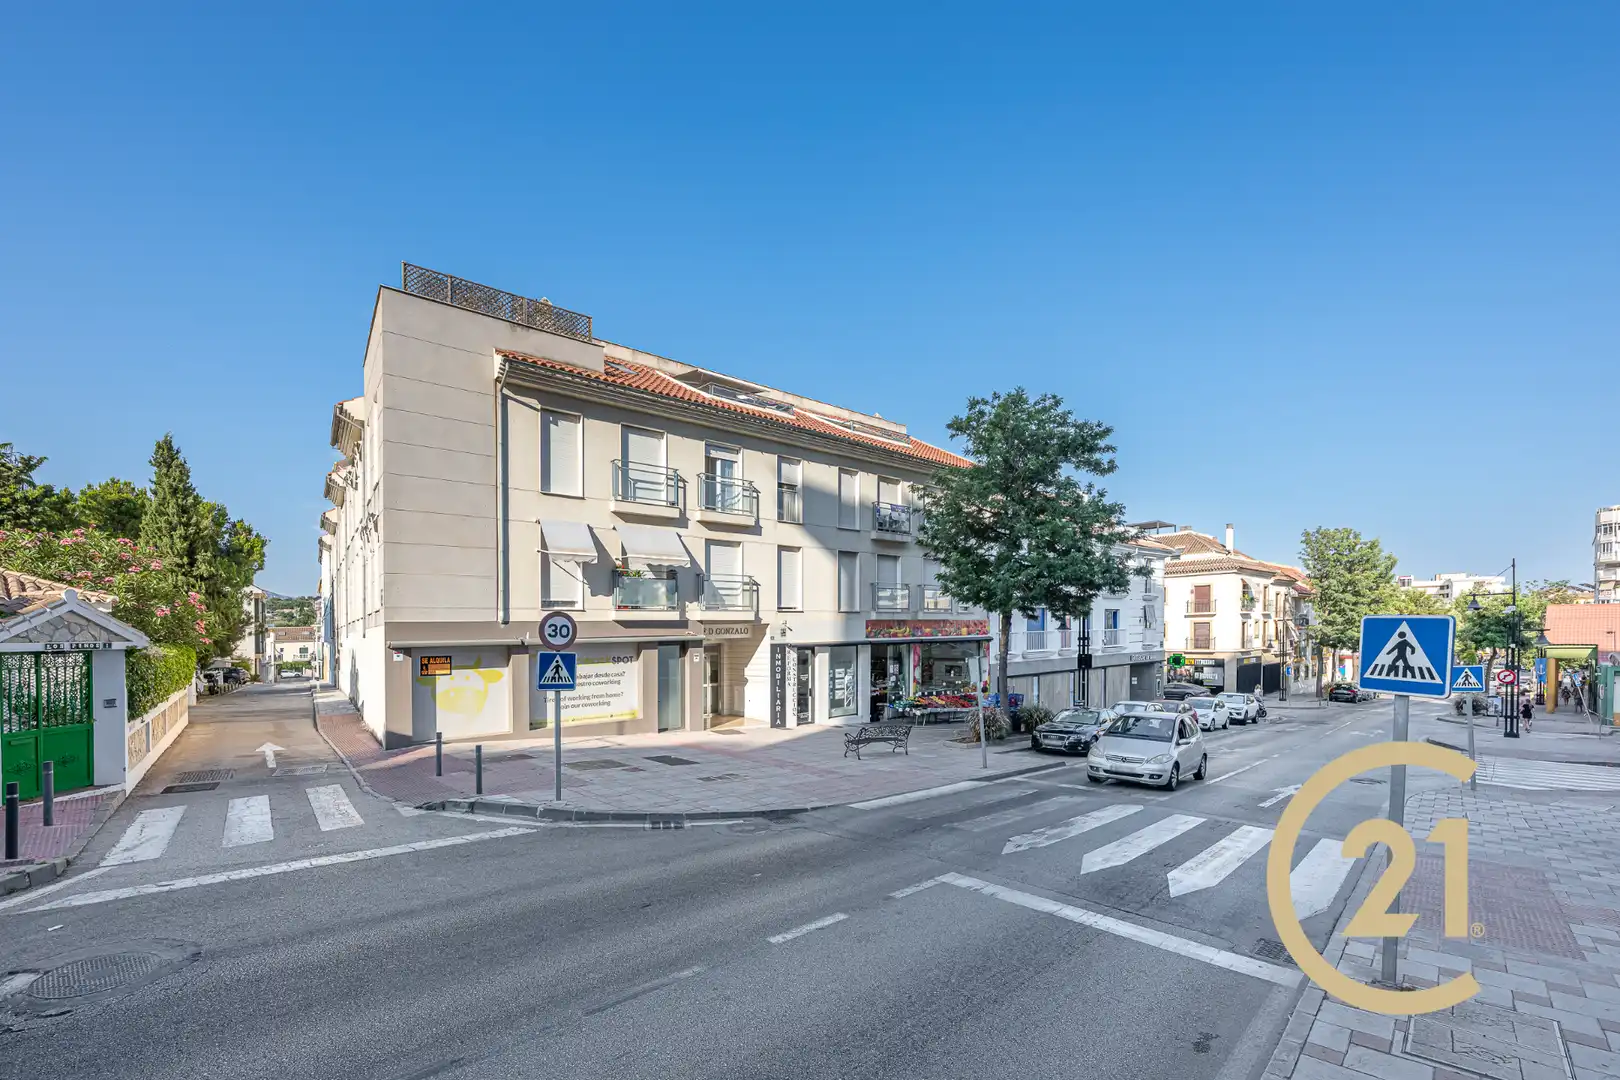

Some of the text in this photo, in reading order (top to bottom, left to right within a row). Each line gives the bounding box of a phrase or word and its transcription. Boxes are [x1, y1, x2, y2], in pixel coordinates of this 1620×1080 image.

[547, 623, 570, 638] 30
[715, 627, 749, 635] GONZALO
[581, 700, 611, 708] coworking
